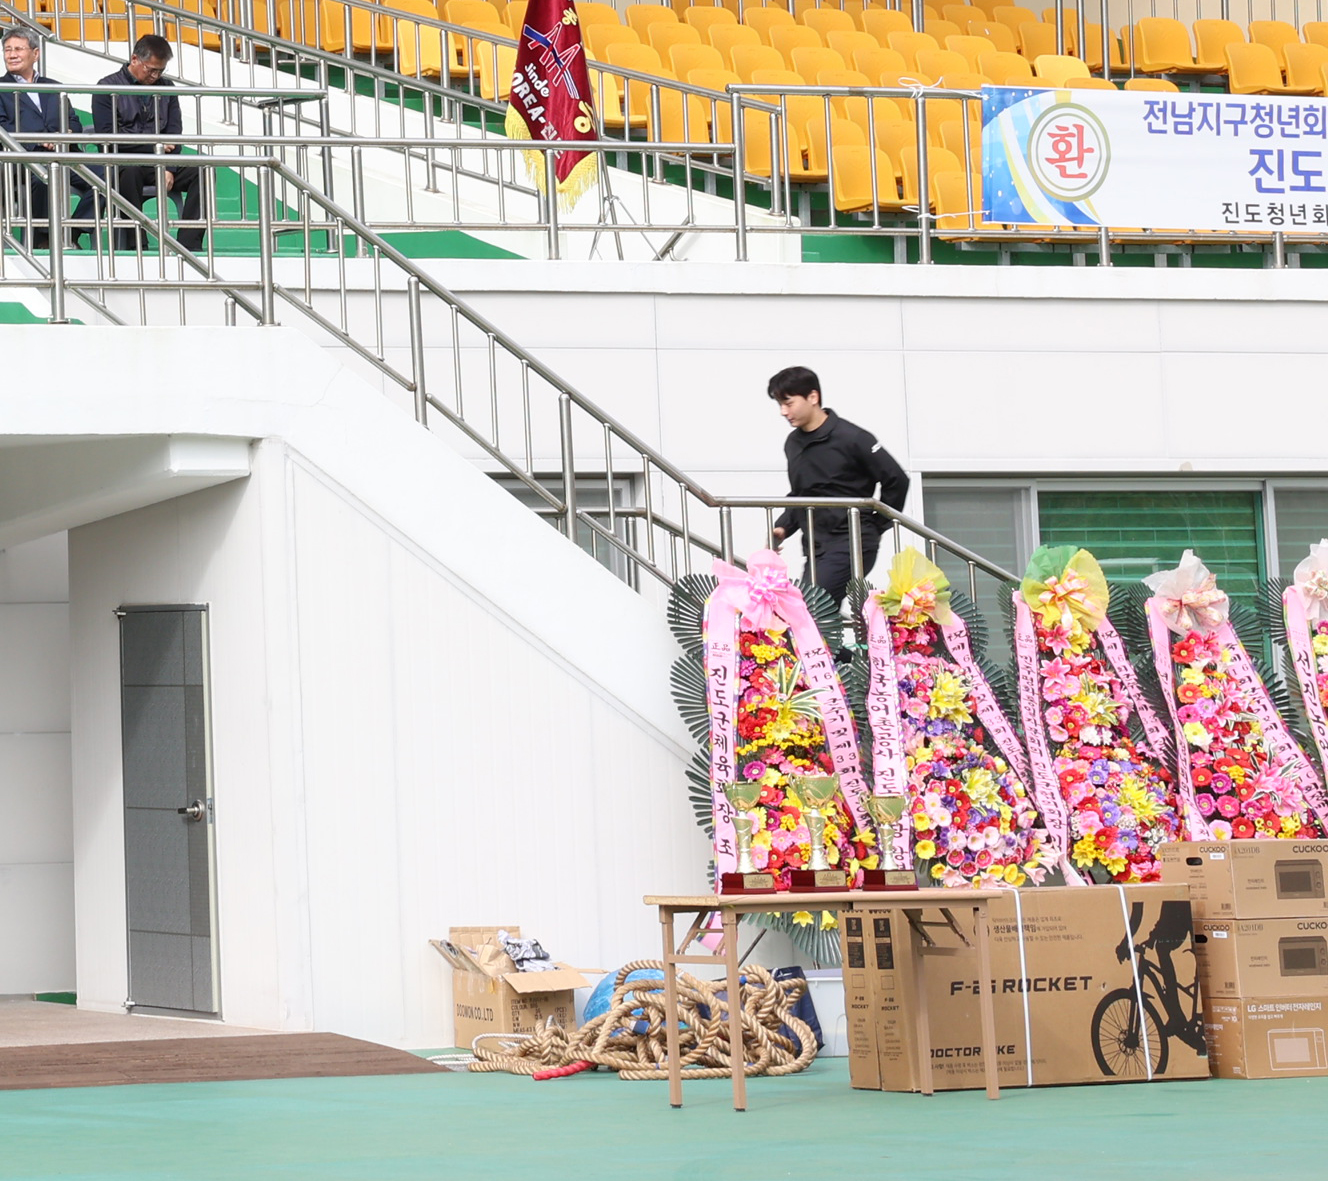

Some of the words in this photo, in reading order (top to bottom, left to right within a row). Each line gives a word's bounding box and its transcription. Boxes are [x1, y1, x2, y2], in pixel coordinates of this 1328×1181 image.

[1143, 100, 1328, 140] 전남지구청년회
[1045, 123, 1094, 179] 환
[1248, 148, 1327, 194] 진도
[1002, 976, 1093, 994] ROCKET
